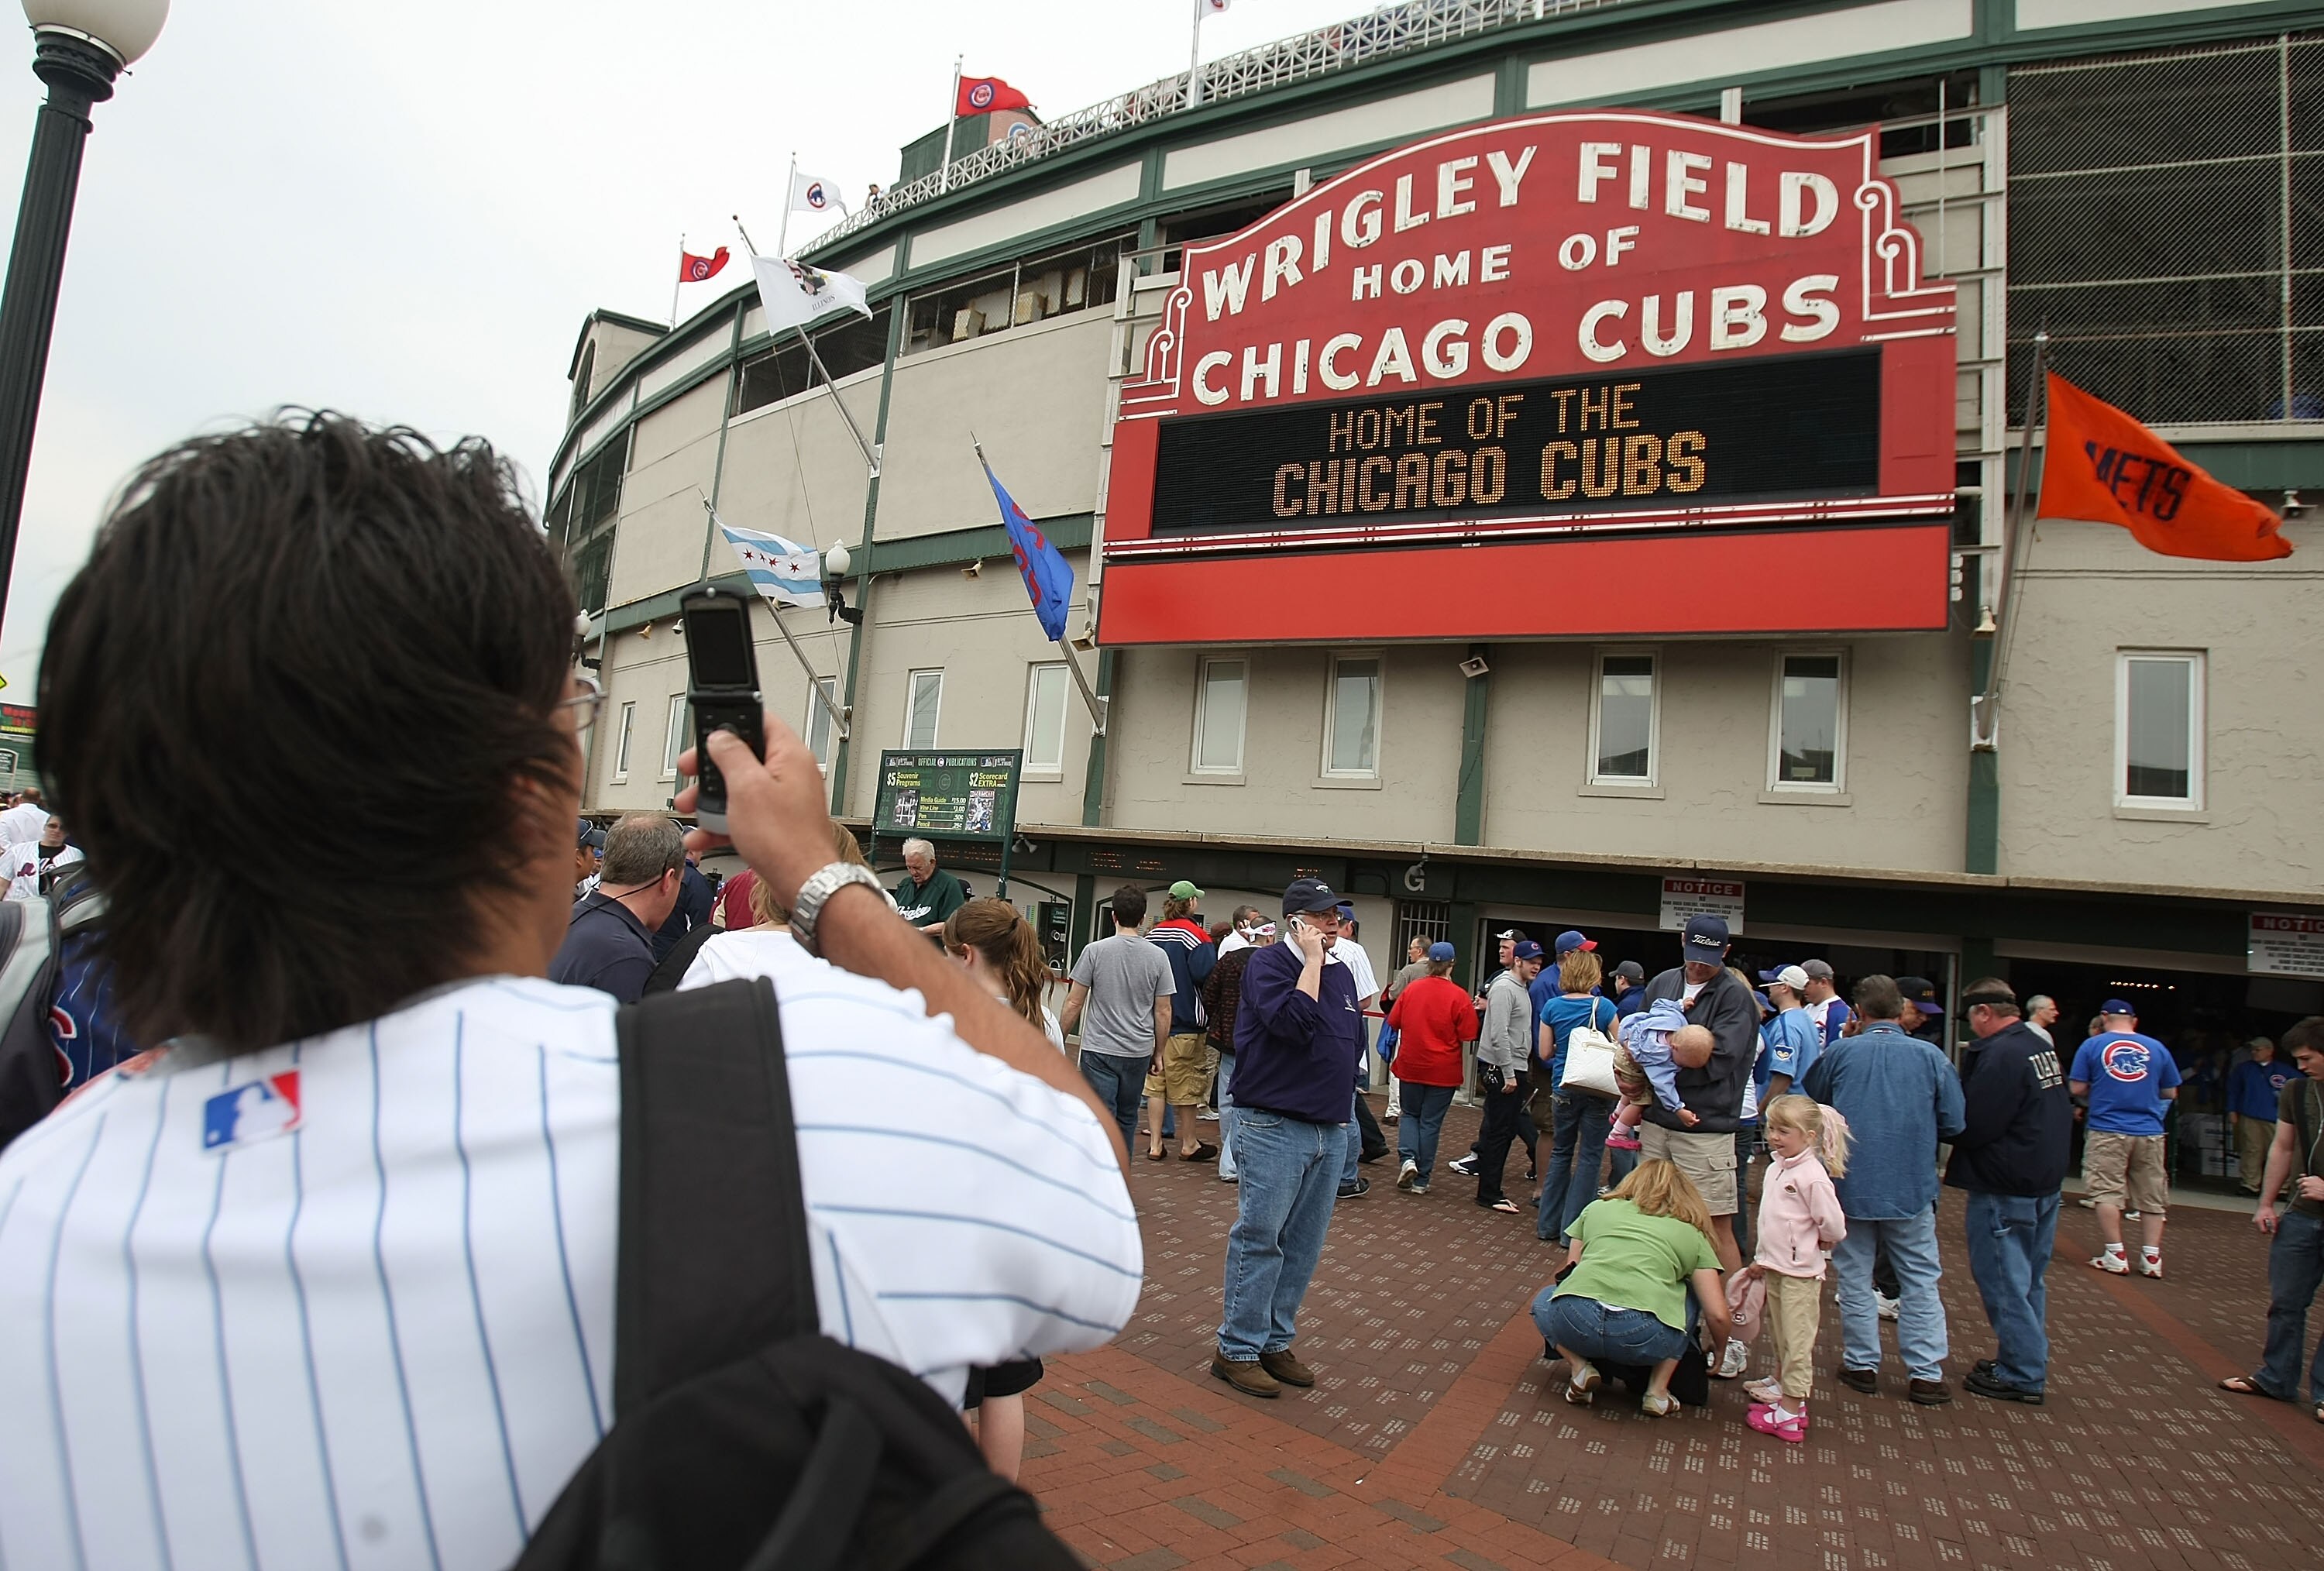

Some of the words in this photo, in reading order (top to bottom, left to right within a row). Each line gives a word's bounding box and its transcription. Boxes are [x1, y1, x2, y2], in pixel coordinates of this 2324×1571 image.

[1203, 146, 1536, 321] WRIGLEY
[1578, 142, 1839, 239] FIELD
[1353, 244, 1511, 301] HOME
[1559, 226, 1639, 271] OF
[1193, 312, 1532, 406] CHICAGO
[1579, 274, 1841, 363] CUBS
[1329, 401, 1443, 452] HOME
[1468, 394, 1523, 440] OF
[1551, 383, 1641, 431] THE
[1273, 446, 1505, 517] CHICAGO
[1542, 431, 1707, 500] CUBS
[2085, 439, 2194, 522] METS
[918, 758, 937, 767] OFFICIAL
[945, 758, 977, 767] PUBLICATIONS
[886, 772, 896, 786] $5
[896, 779, 921, 788] Programs
[969, 772, 979, 787] $2
[1404, 865, 1425, 892] G
[1673, 882, 1734, 895] NOTICE
[2263, 918, 2324, 932] NOTIC
